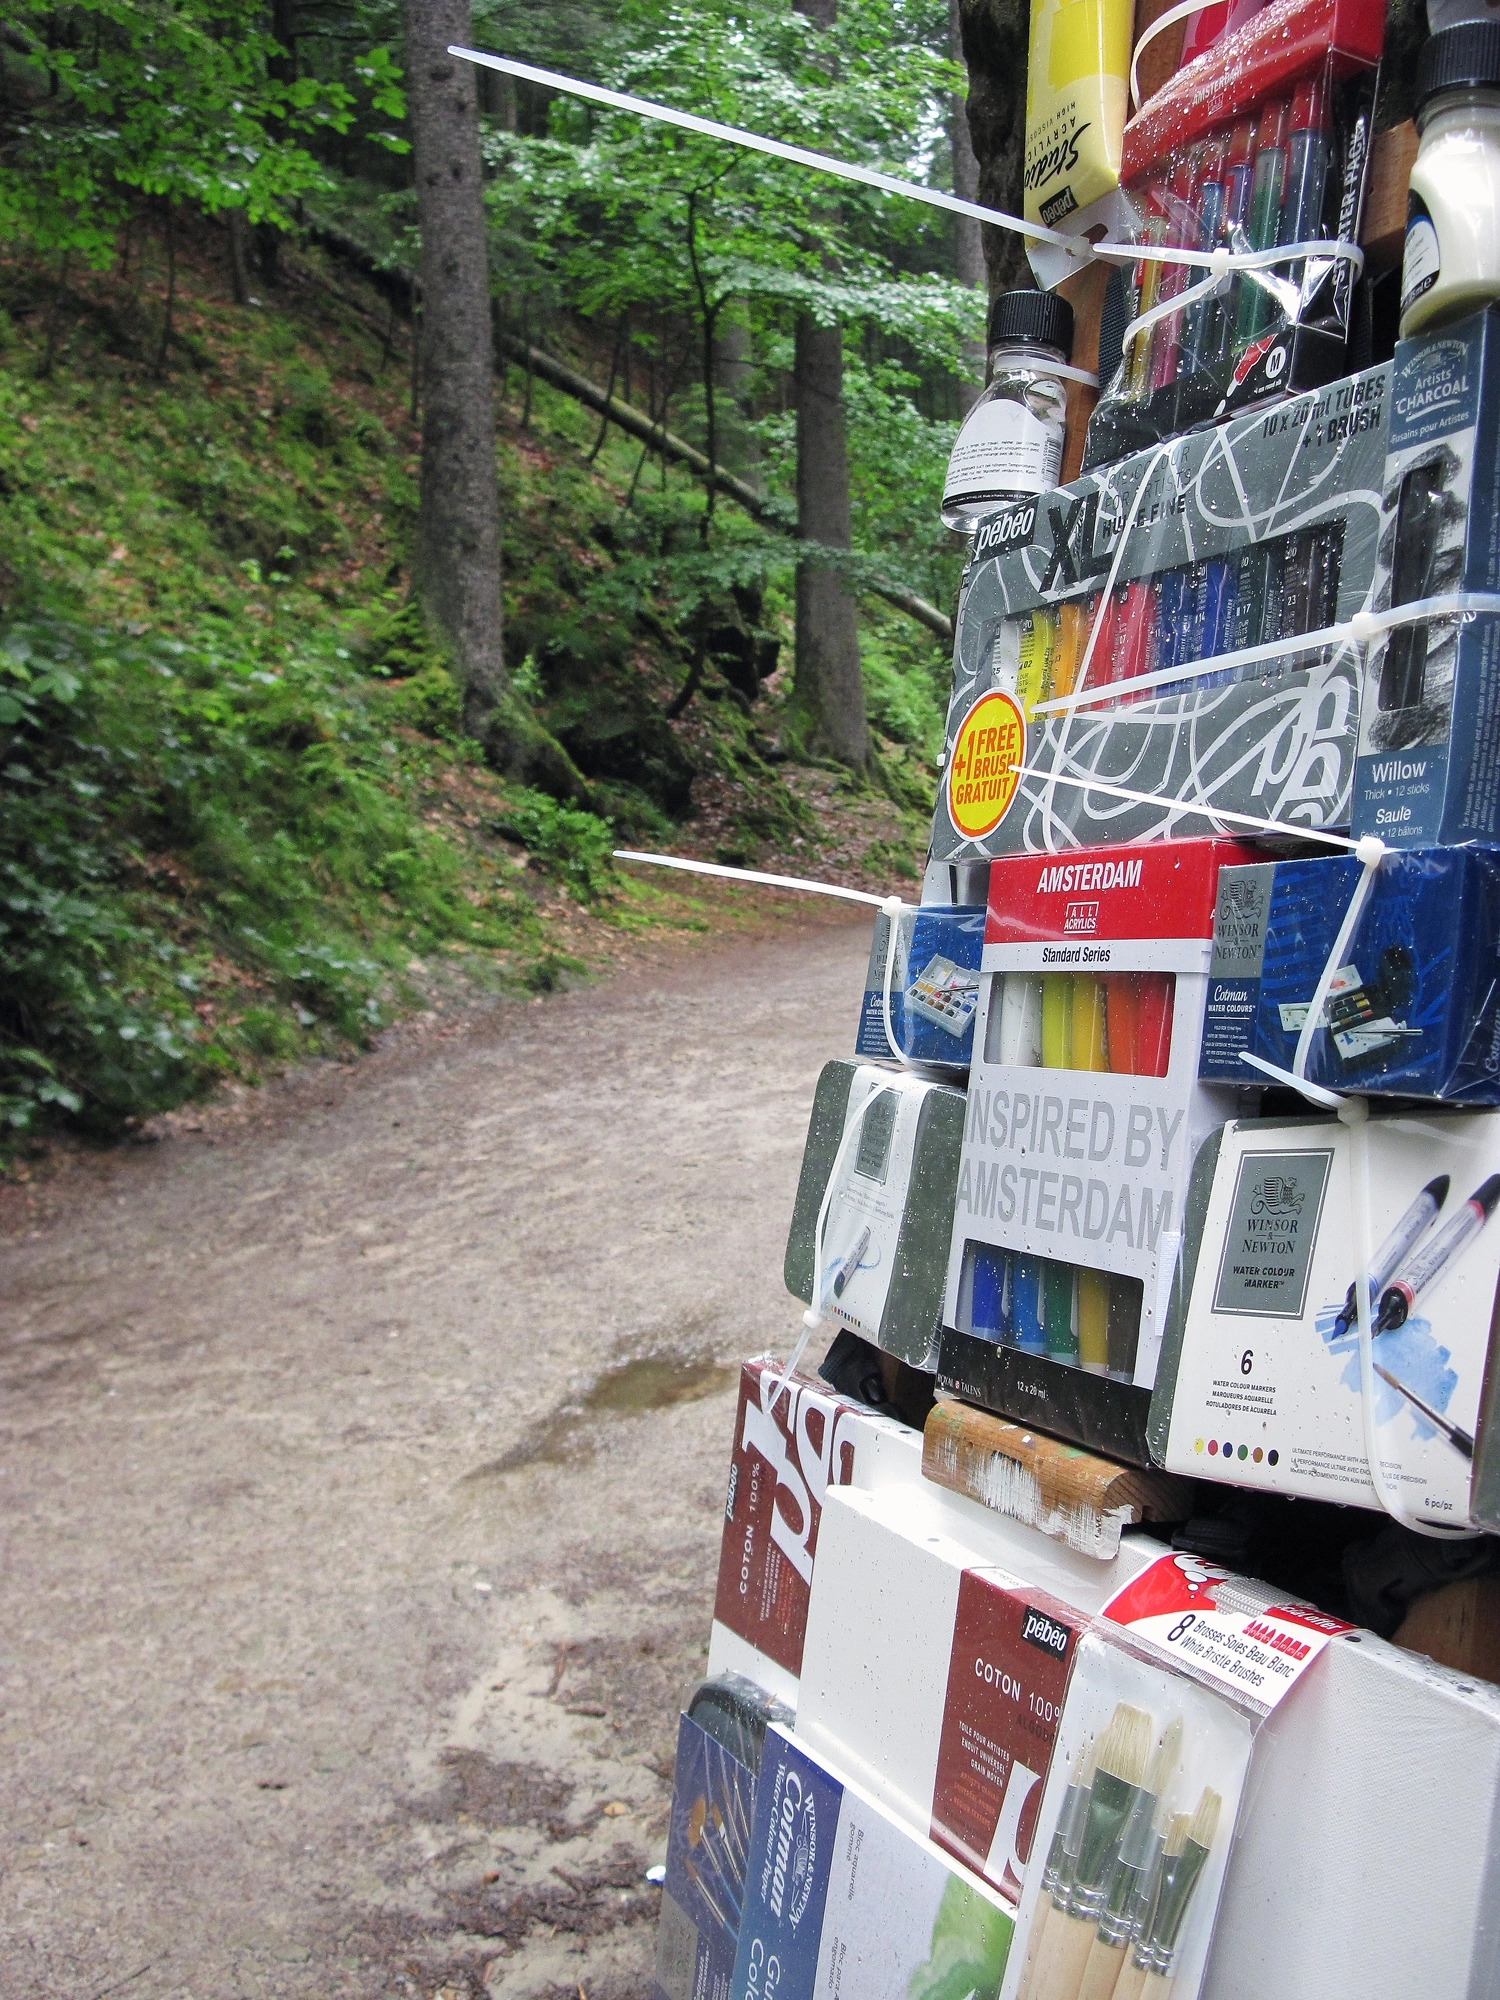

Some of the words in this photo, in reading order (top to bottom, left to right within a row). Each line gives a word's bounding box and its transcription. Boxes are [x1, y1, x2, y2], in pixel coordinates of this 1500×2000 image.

[1027, 116, 1076, 161] ACRYLIC
[1270, 353, 1281, 372] M
[1415, 364, 1455, 391] Artists'
[1263, 415, 1278, 438] 10
[1280, 414, 1289, 432] x
[1335, 374, 1385, 411] TUBES
[1397, 375, 1469, 415] CHARCOAL
[1327, 403, 1382, 443] BRUSH
[1420, 422, 1438, 437] pour
[1439, 411, 1469, 428] Artistes
[1039, 491, 1114, 593] XL
[1242, 603, 1251, 614] 17
[1287, 595, 1296, 606] 23
[977, 723, 1017, 755] FREE
[974, 752, 1016, 779] BRUSH
[1372, 761, 1426, 783] Willow
[956, 777, 1010, 805] GRATUIT
[1364, 789, 1385, 800] Thick
[1395, 785, 1405, 796] 12
[1407, 783, 1429, 795] sticks
[1376, 806, 1411, 824] Saule
[1388, 828, 1396, 837] 12
[1036, 860, 1143, 894] AMSTERDAM
[1064, 918, 1097, 930] ACRYLICS
[1218, 923, 1259, 938] WINSOR
[1042, 947, 1082, 963] Standard
[1083, 946, 1111, 963] Series
[1214, 984, 1248, 1002] Cotman
[1208, 1004, 1226, 1013] WATER
[964, 1089, 1115, 1162] INSPIRED
[1124, 1105, 1185, 1171] BY
[957, 1158, 1173, 1251] AMSTERDAM
[1247, 1219, 1298, 1234] WINSOR
[1267, 1232, 1273, 1240] &
[1242, 1239, 1296, 1254] NEWTON
[1233, 1266, 1260, 1275] WATER
[1262, 1267, 1295, 1277] COLOUR
[1241, 1349, 1254, 1375] 6
[961, 1382, 981, 1397] TALENS
[1017, 1381, 1025, 1391] 12
[1030, 1386, 1037, 1396] 20
[1038, 1390, 1046, 1399] ml
[1212, 1391, 1243, 1400] MARQUEURS
[1244, 1394, 1273, 1404] AQUARELLE
[1230, 1381, 1250, 1390] COLOUR
[1251, 1384, 1276, 1393] MARKERS
[1206, 1401, 1242, 1411] ROTULADORES
[1313, 1450, 1346, 1461] PERFORMANCE
[1425, 1498, 1430, 1506] 6
[1431, 1500, 1453, 1510] pc/pz
[739, 1525, 755, 1594] COTON
[749, 1462, 761, 1513] 100%
[1304, 1615, 1343, 1631] offer
[1167, 1613, 1197, 1642] 8
[1193, 1620, 1224, 1644] Brosses
[1225, 1635, 1251, 1655] Soies
[1246, 1643, 1269, 1666] Beau
[1267, 1653, 1295, 1679] Blanc
[1179, 1635, 1204, 1657] White
[1201, 1647, 1231, 1670] Bristle
[1229, 1658, 1266, 1688] Brushes
[975, 1658, 1020, 1702] COTON
[959, 1721, 972, 1736] TOILE
[973, 1730, 986, 1745] POUR
[987, 1738, 1011, 1762] ARTISTES
[961, 1737, 979, 1755] ENDUIT
[979, 1748, 1006, 1774] UNIVERSEL
[773, 1762, 787, 1805] Water
[971, 1759, 985, 1775] GRAIN
[987, 1771, 1004, 1788] MOYEN
[766, 1806, 781, 1857] Colour
[804, 1792, 817, 1862] WINSOR
[770, 1771, 802, 1918] Cotman
[856, 1829, 865, 1853] Bloc
[762, 1858, 776, 1904] Paper
[849, 1853, 861, 1901] aquarelle
[788, 1875, 813, 1932] NEWTON
[828, 1936, 839, 1989] engomado
[839, 1942, 847, 1963] Bloc
[836, 1963, 845, 1986] para
